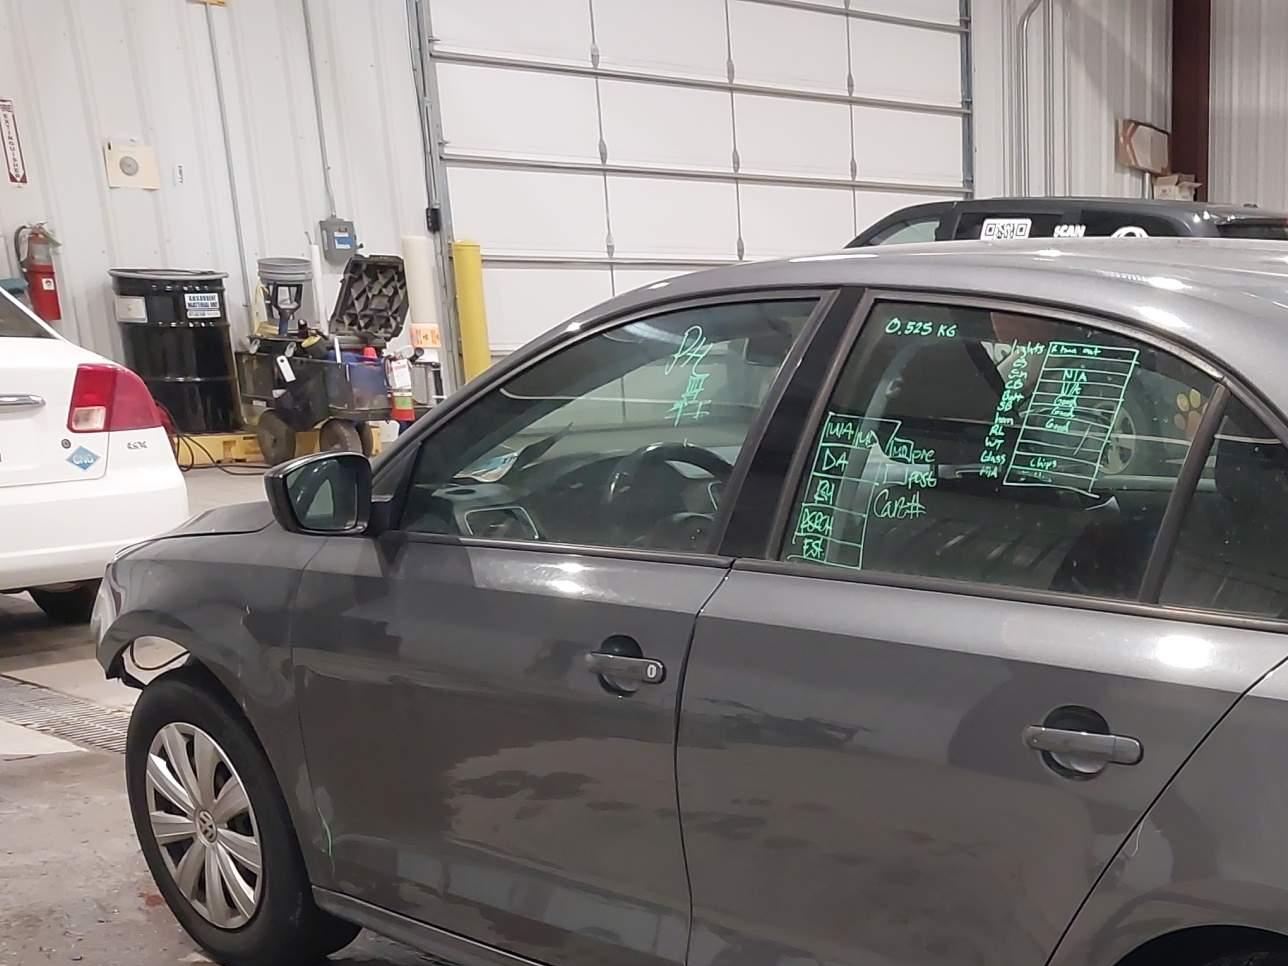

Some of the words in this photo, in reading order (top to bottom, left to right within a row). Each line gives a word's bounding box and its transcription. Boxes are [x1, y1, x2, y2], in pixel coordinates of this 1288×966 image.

[885, 317, 933, 336] 0.525
[937, 324, 957, 337] KG
[1063, 369, 1088, 382] N/A
